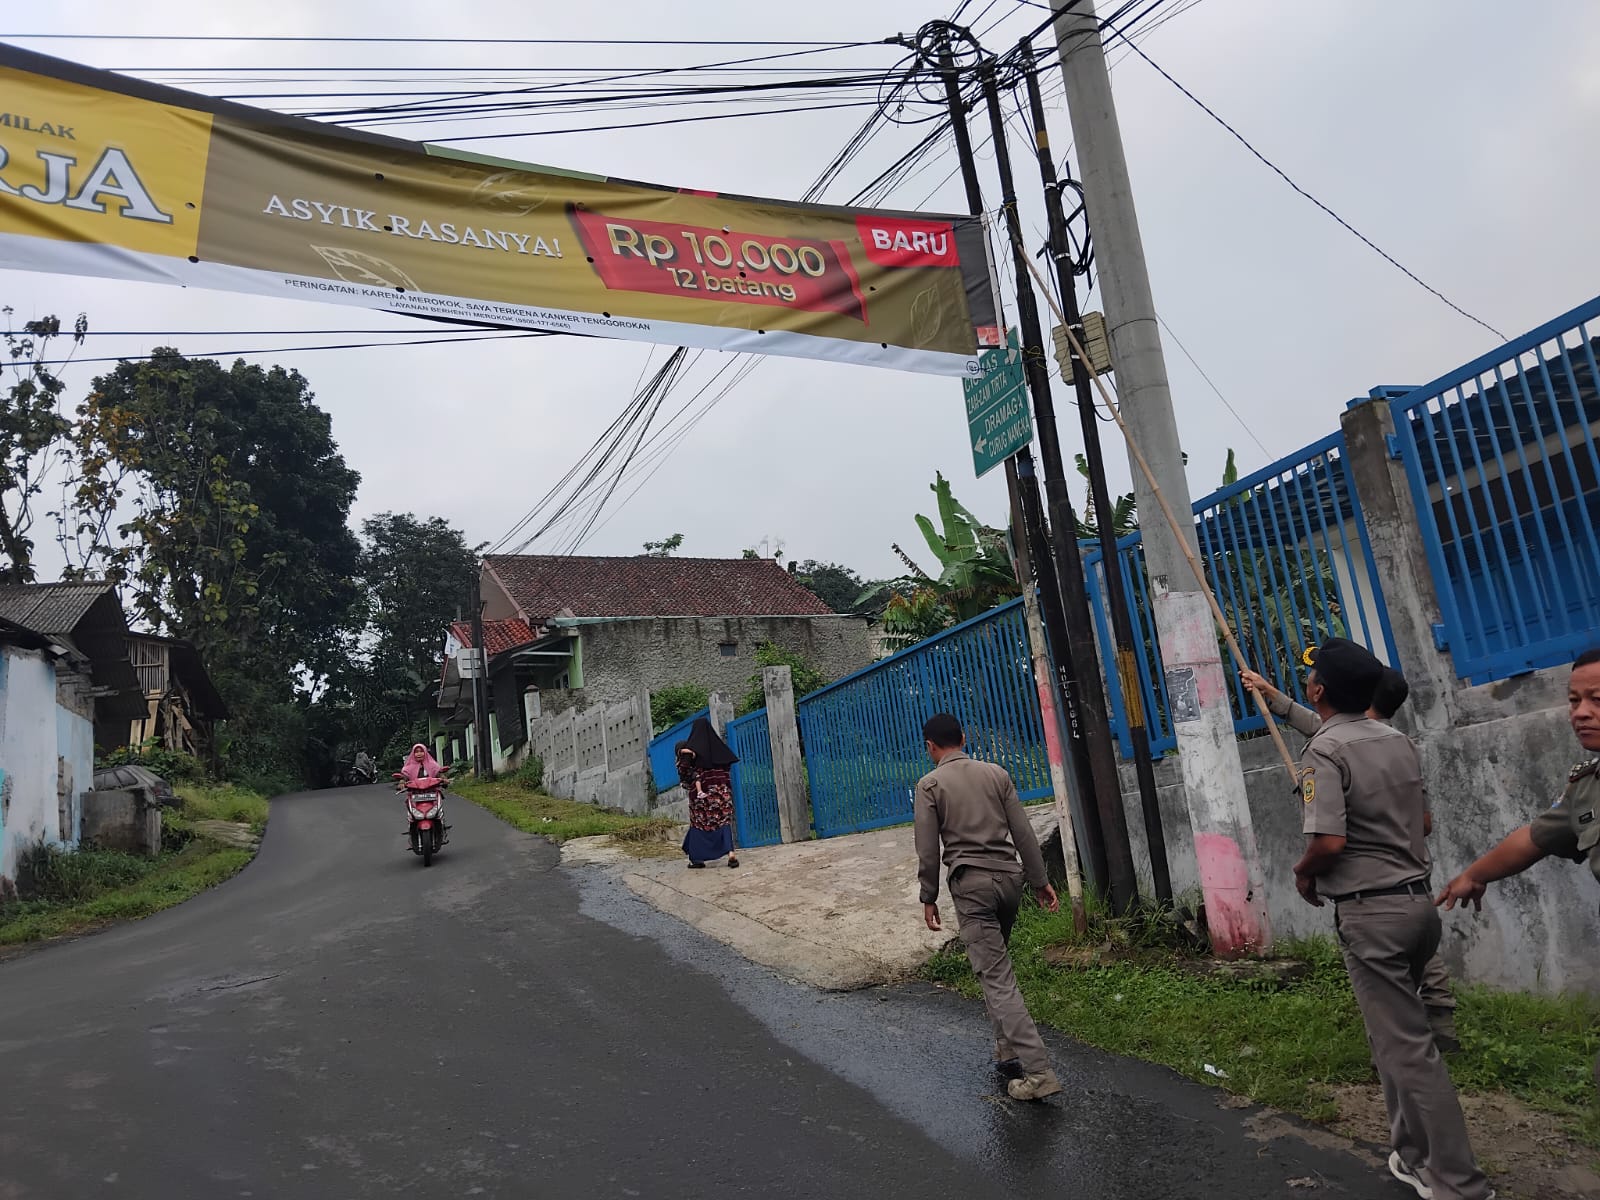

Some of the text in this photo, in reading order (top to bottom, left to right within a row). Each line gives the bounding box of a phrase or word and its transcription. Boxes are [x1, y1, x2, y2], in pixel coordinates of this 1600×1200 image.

[262, 194, 563, 258] ASYIK RASANYA!
[871, 228, 948, 256] BARU
[606, 223, 826, 277] Rp 10.000
[666, 267, 797, 301] 12 batang
[284, 279, 359, 295] PERINGATAN:
[362, 288, 407, 301] KARENA
[465, 303, 492, 312] SAYA
[493, 305, 540, 318] TERKENA
[540, 312, 579, 323] KANKER
[581, 316, 651, 331] TENGGOROKAN
[390, 301, 429, 312] LAYANAN
[430, 307, 472, 318] BERHENTI
[473, 312, 514, 322] MEROKOK
[984, 393, 1023, 434] DRAMAGA
[988, 431, 1008, 458] CURUG
